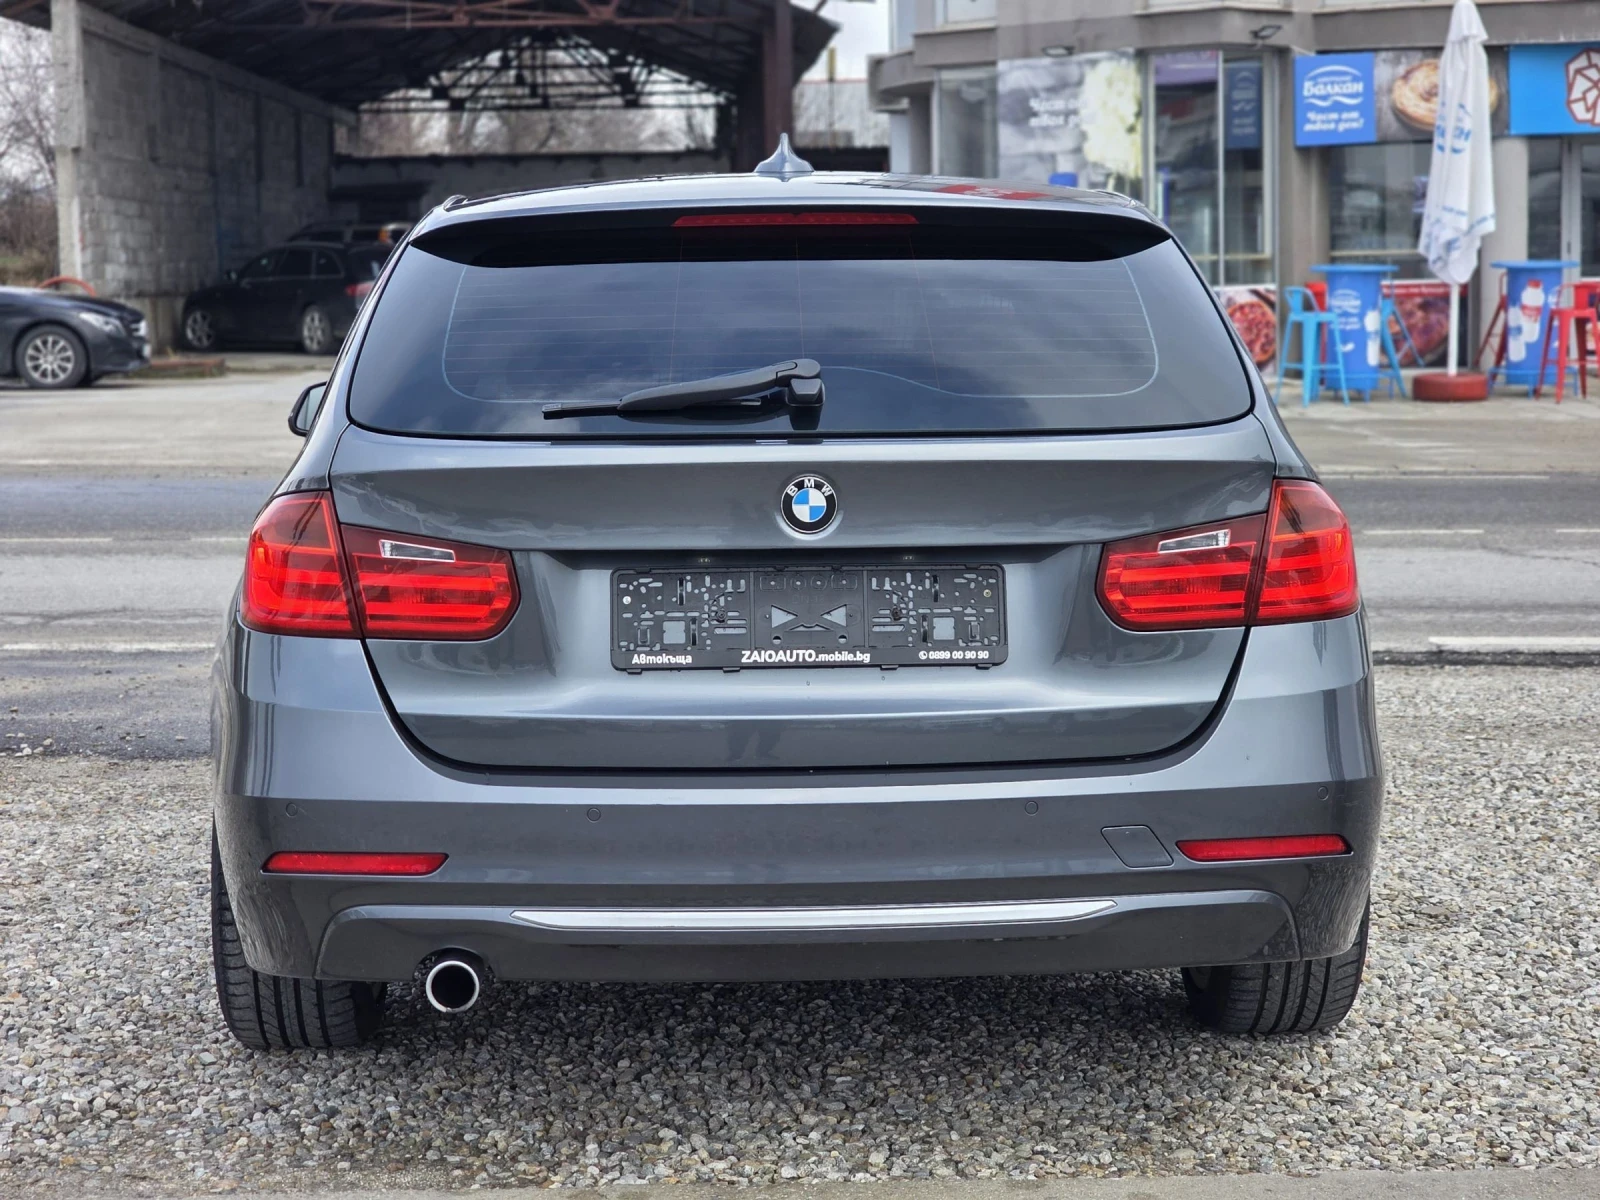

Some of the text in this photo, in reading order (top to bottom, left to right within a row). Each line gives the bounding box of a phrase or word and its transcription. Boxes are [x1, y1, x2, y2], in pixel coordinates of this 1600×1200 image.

[786, 478, 833, 497] BMW
[632, 653, 693, 665] Автокъща
[741, 649, 871, 664] ZAIOAUTO.mobile.bg
[928, 650, 990, 660] 0899 00 90 90
